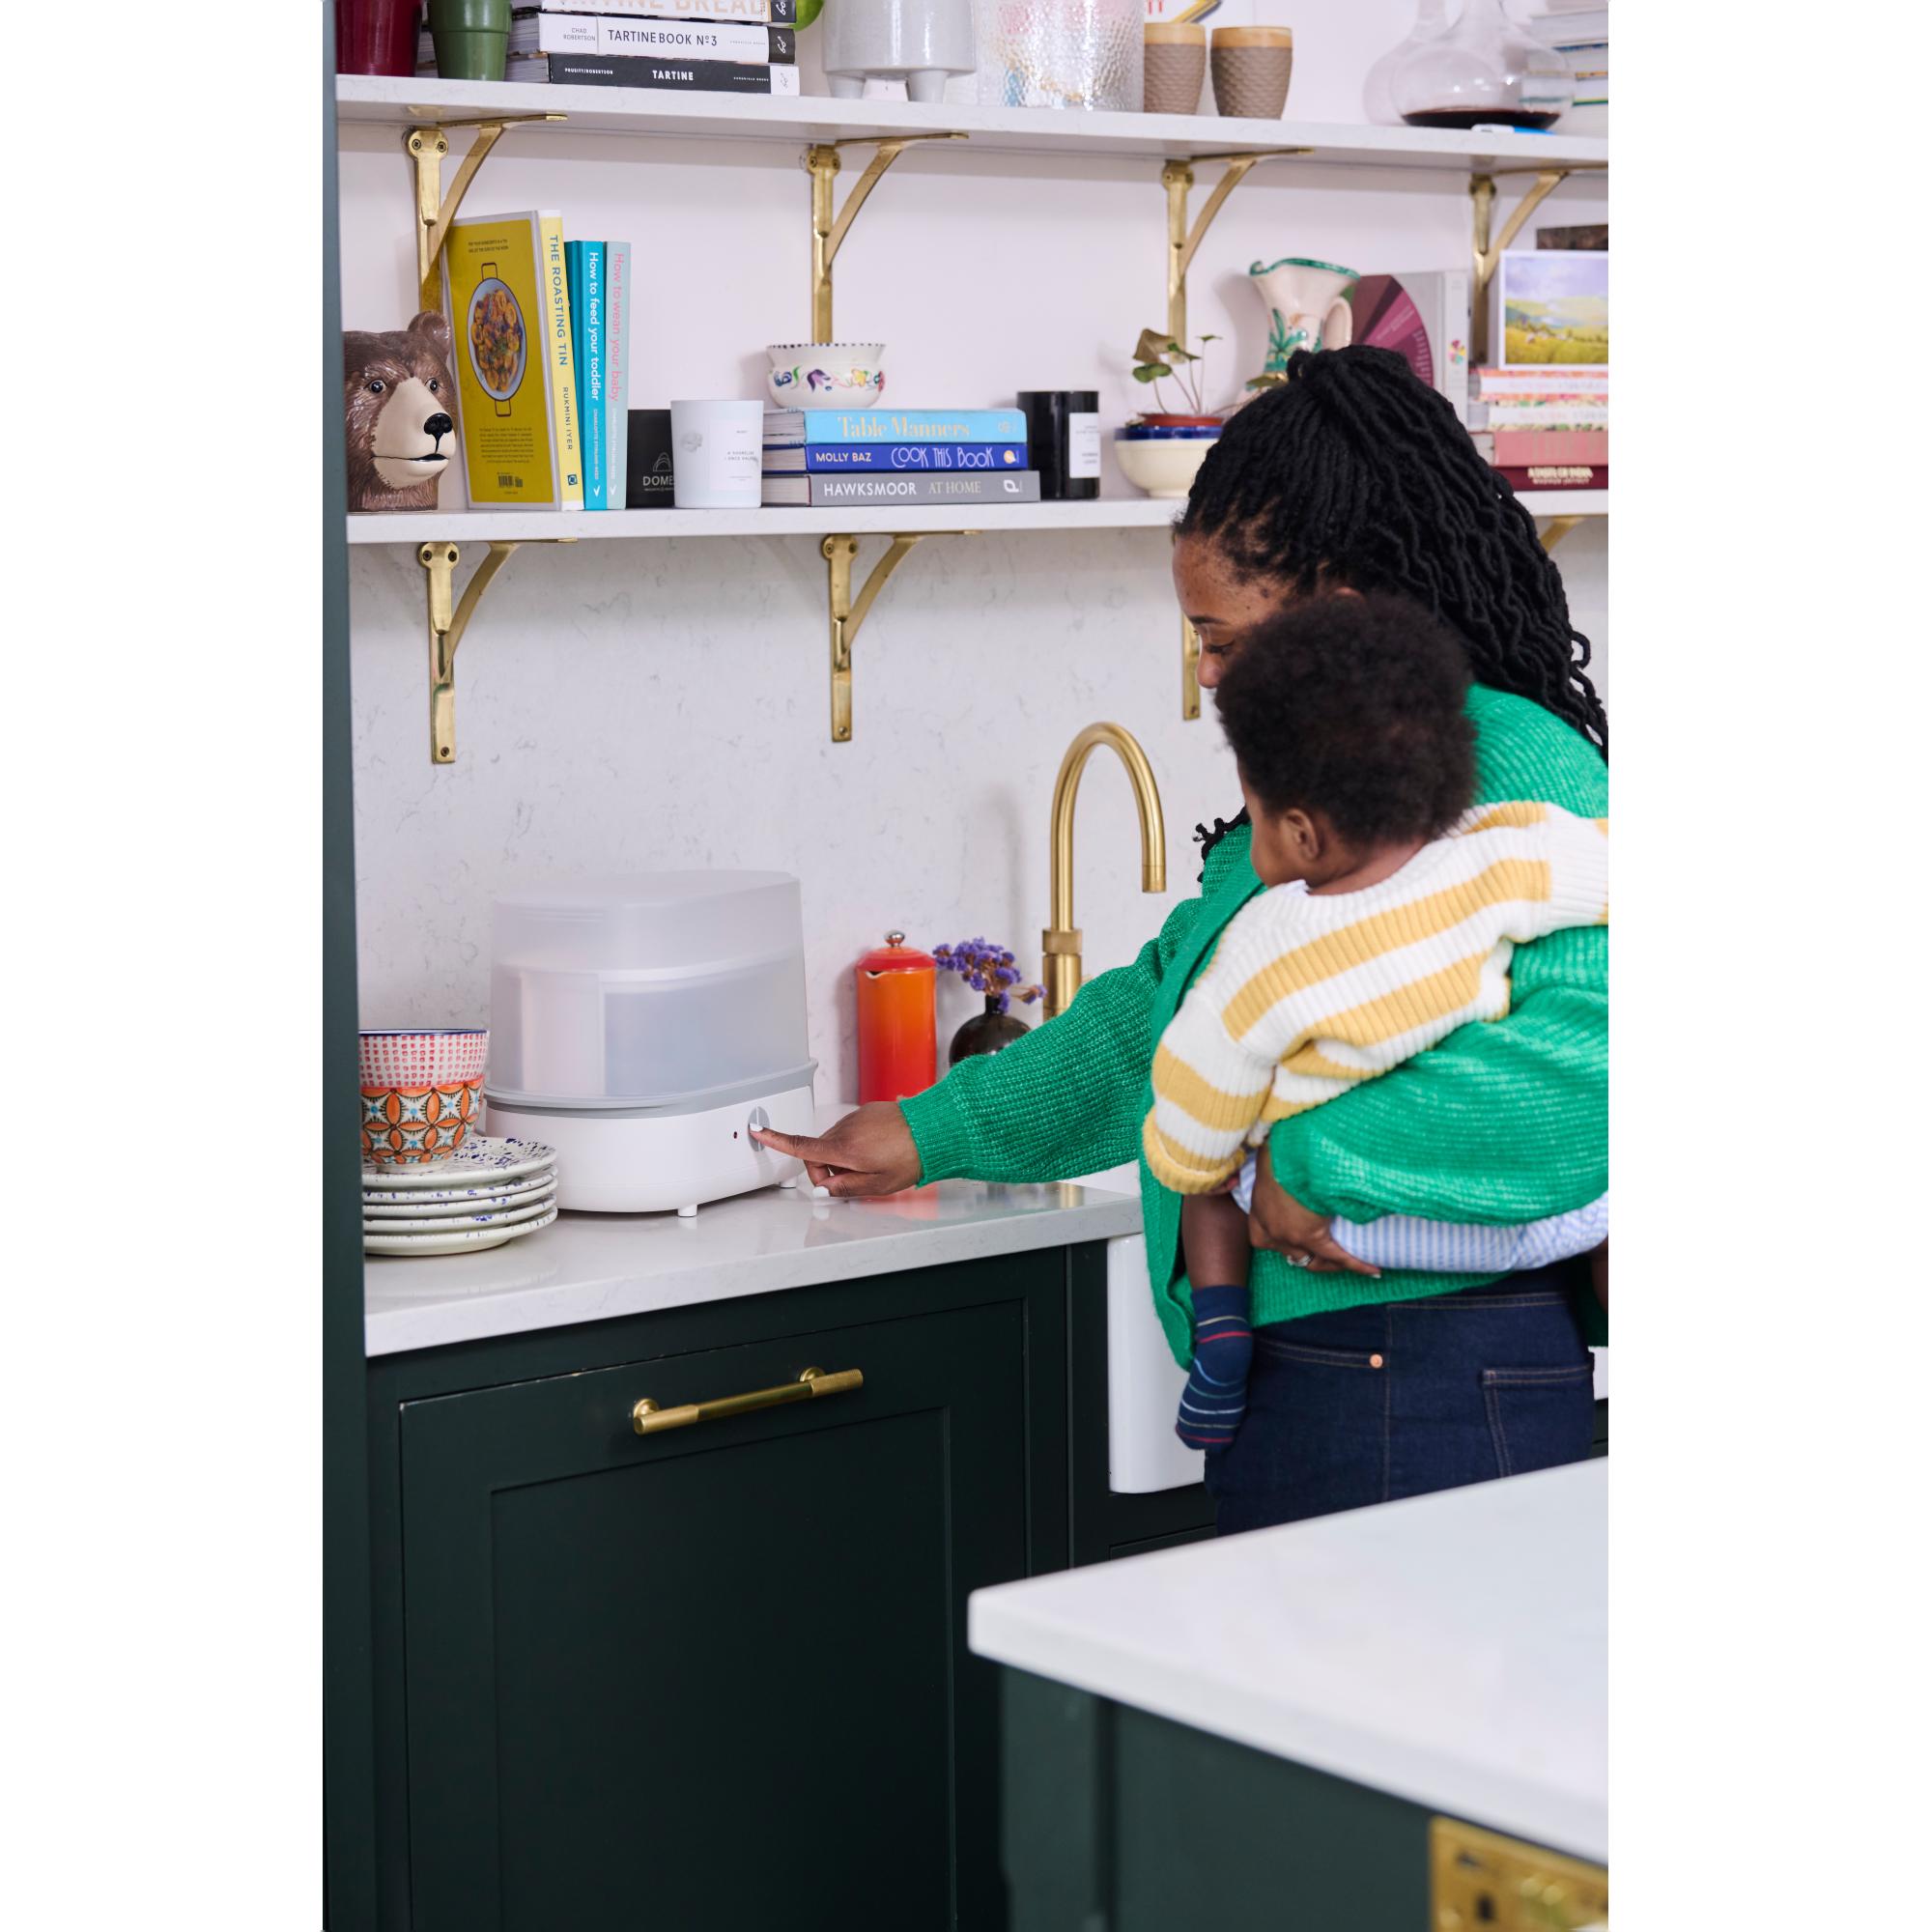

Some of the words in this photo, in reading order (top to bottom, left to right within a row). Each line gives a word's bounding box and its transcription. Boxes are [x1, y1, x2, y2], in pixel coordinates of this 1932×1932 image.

[608, 29, 656, 43] TARTINE
[659, 32, 692, 45] BOOK
[652, 70, 694, 81] TARTINE
[550, 235, 560, 262] THE
[589, 252, 599, 280] How
[614, 253, 625, 281] How
[589, 281, 599, 295] to
[612, 286, 622, 298] to
[552, 267, 565, 338] ROASTING
[589, 298, 600, 325] feed
[611, 301, 621, 334] wean
[587, 327, 599, 354] your
[609, 338, 621, 367] your
[558, 343, 568, 366] TIN
[590, 357, 601, 401] toddler
[609, 371, 622, 402] baby
[562, 386, 571, 425] RUKMINI
[838, 416, 887, 439] Table
[891, 416, 971, 439] Manners
[815, 452, 849, 463] MOLLY
[851, 451, 872, 463] BAZ
[823, 482, 917, 497] HAWKSMOOR
[928, 481, 941, 495] AT
[945, 480, 981, 495] HOME
